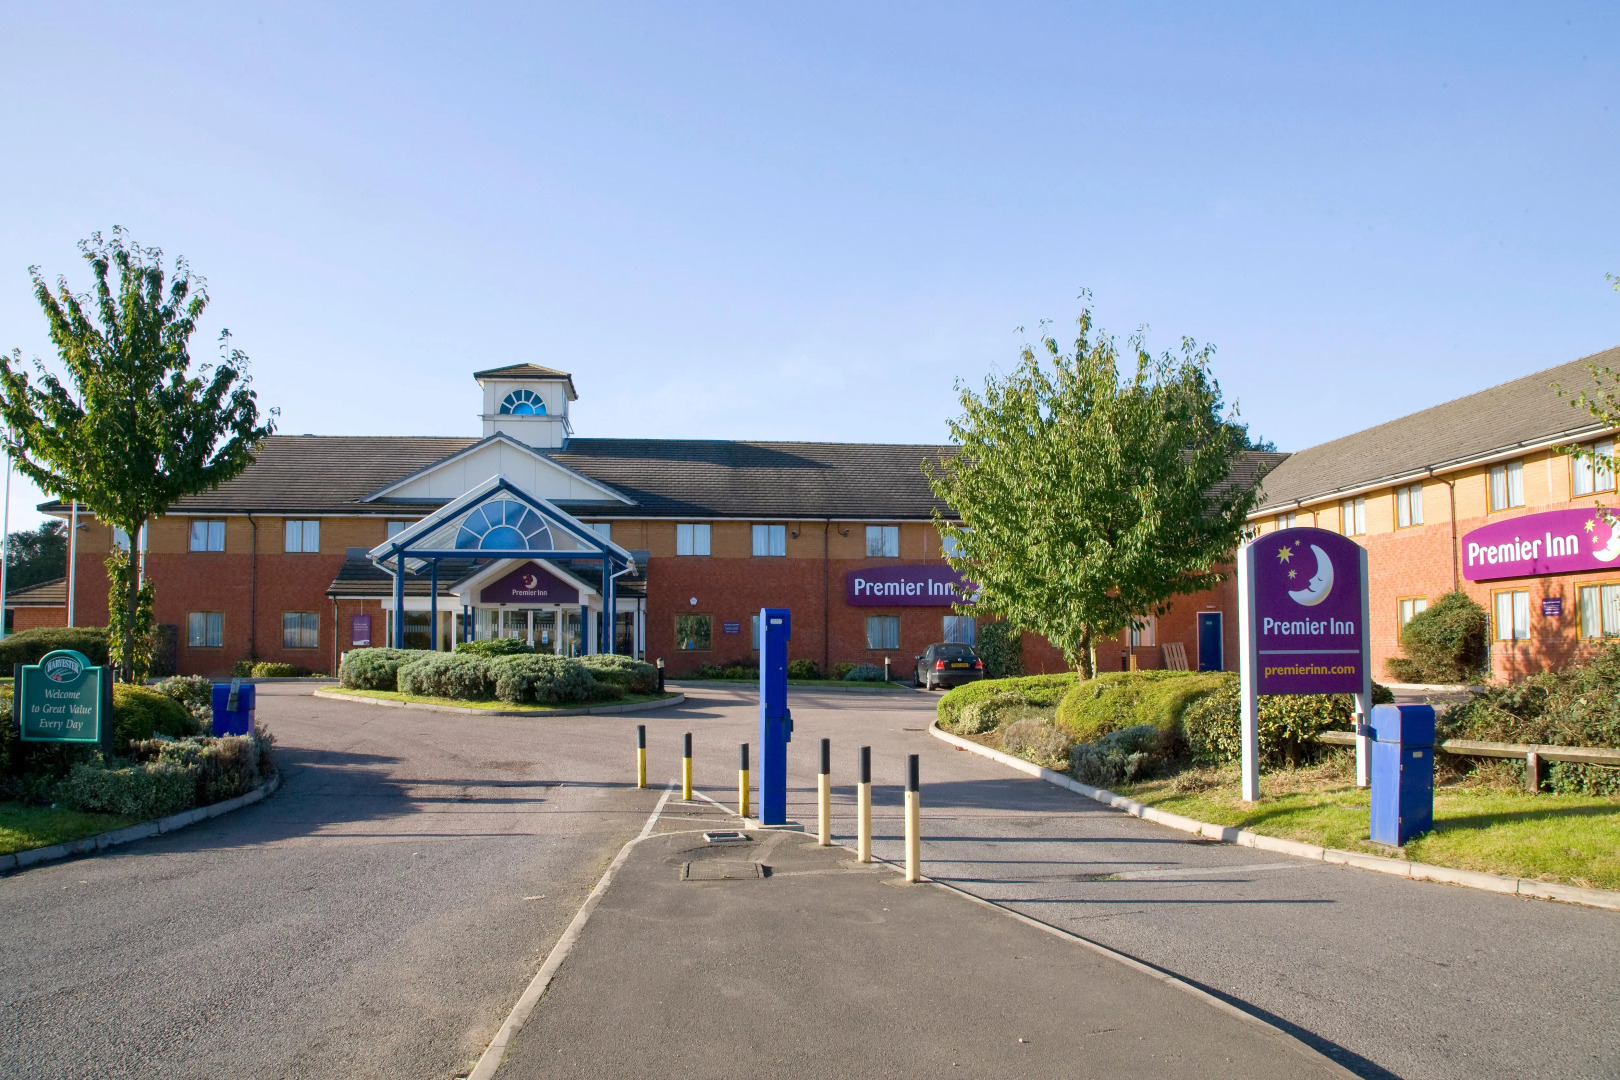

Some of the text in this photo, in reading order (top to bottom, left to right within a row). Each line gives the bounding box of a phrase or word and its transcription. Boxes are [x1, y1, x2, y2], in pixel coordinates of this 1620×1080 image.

[1468, 532, 1579, 566] Premier Inn
[854, 578, 954, 596] Premier Inn
[1263, 617, 1355, 635] Premier Inn
[47, 658, 79, 674] HARVESTER
[1264, 663, 1355, 679] premierinn.com
[45, 689, 80, 699] Welcome
[31, 703, 93, 715] to Great Value
[39, 718, 84, 731] Every Day
